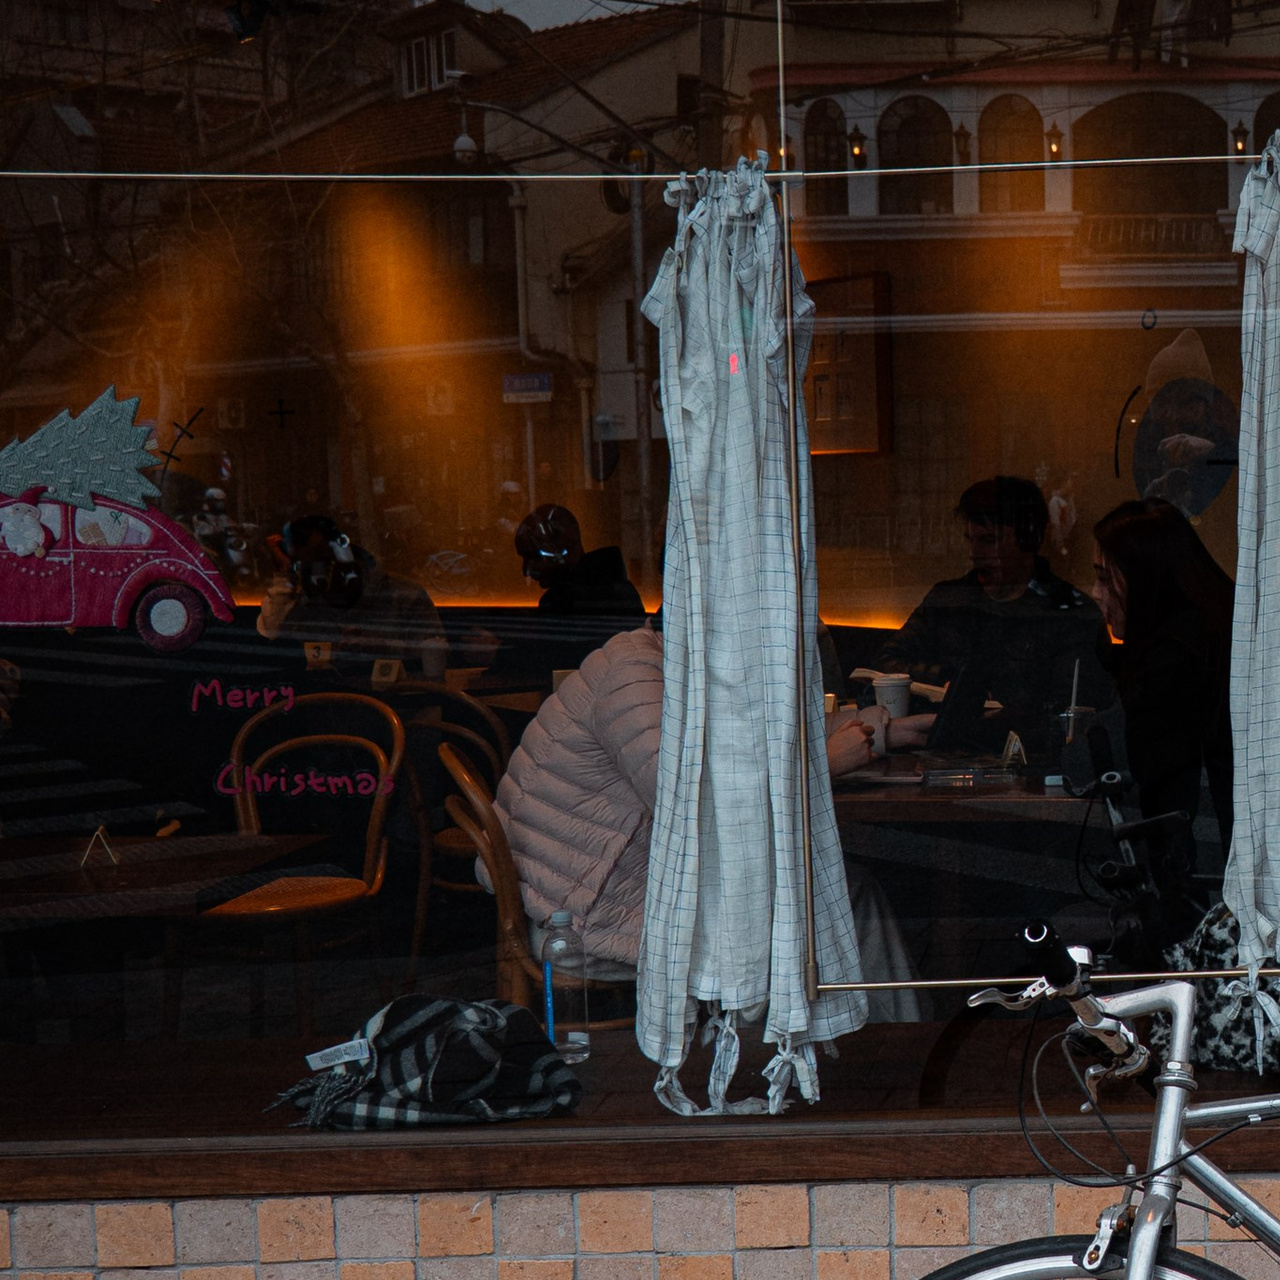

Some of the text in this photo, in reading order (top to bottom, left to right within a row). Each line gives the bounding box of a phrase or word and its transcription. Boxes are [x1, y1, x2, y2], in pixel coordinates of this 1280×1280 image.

[312, 646, 322, 659] 3
[192, 679, 295, 712] Merry
[216, 763, 396, 796] Christmas
